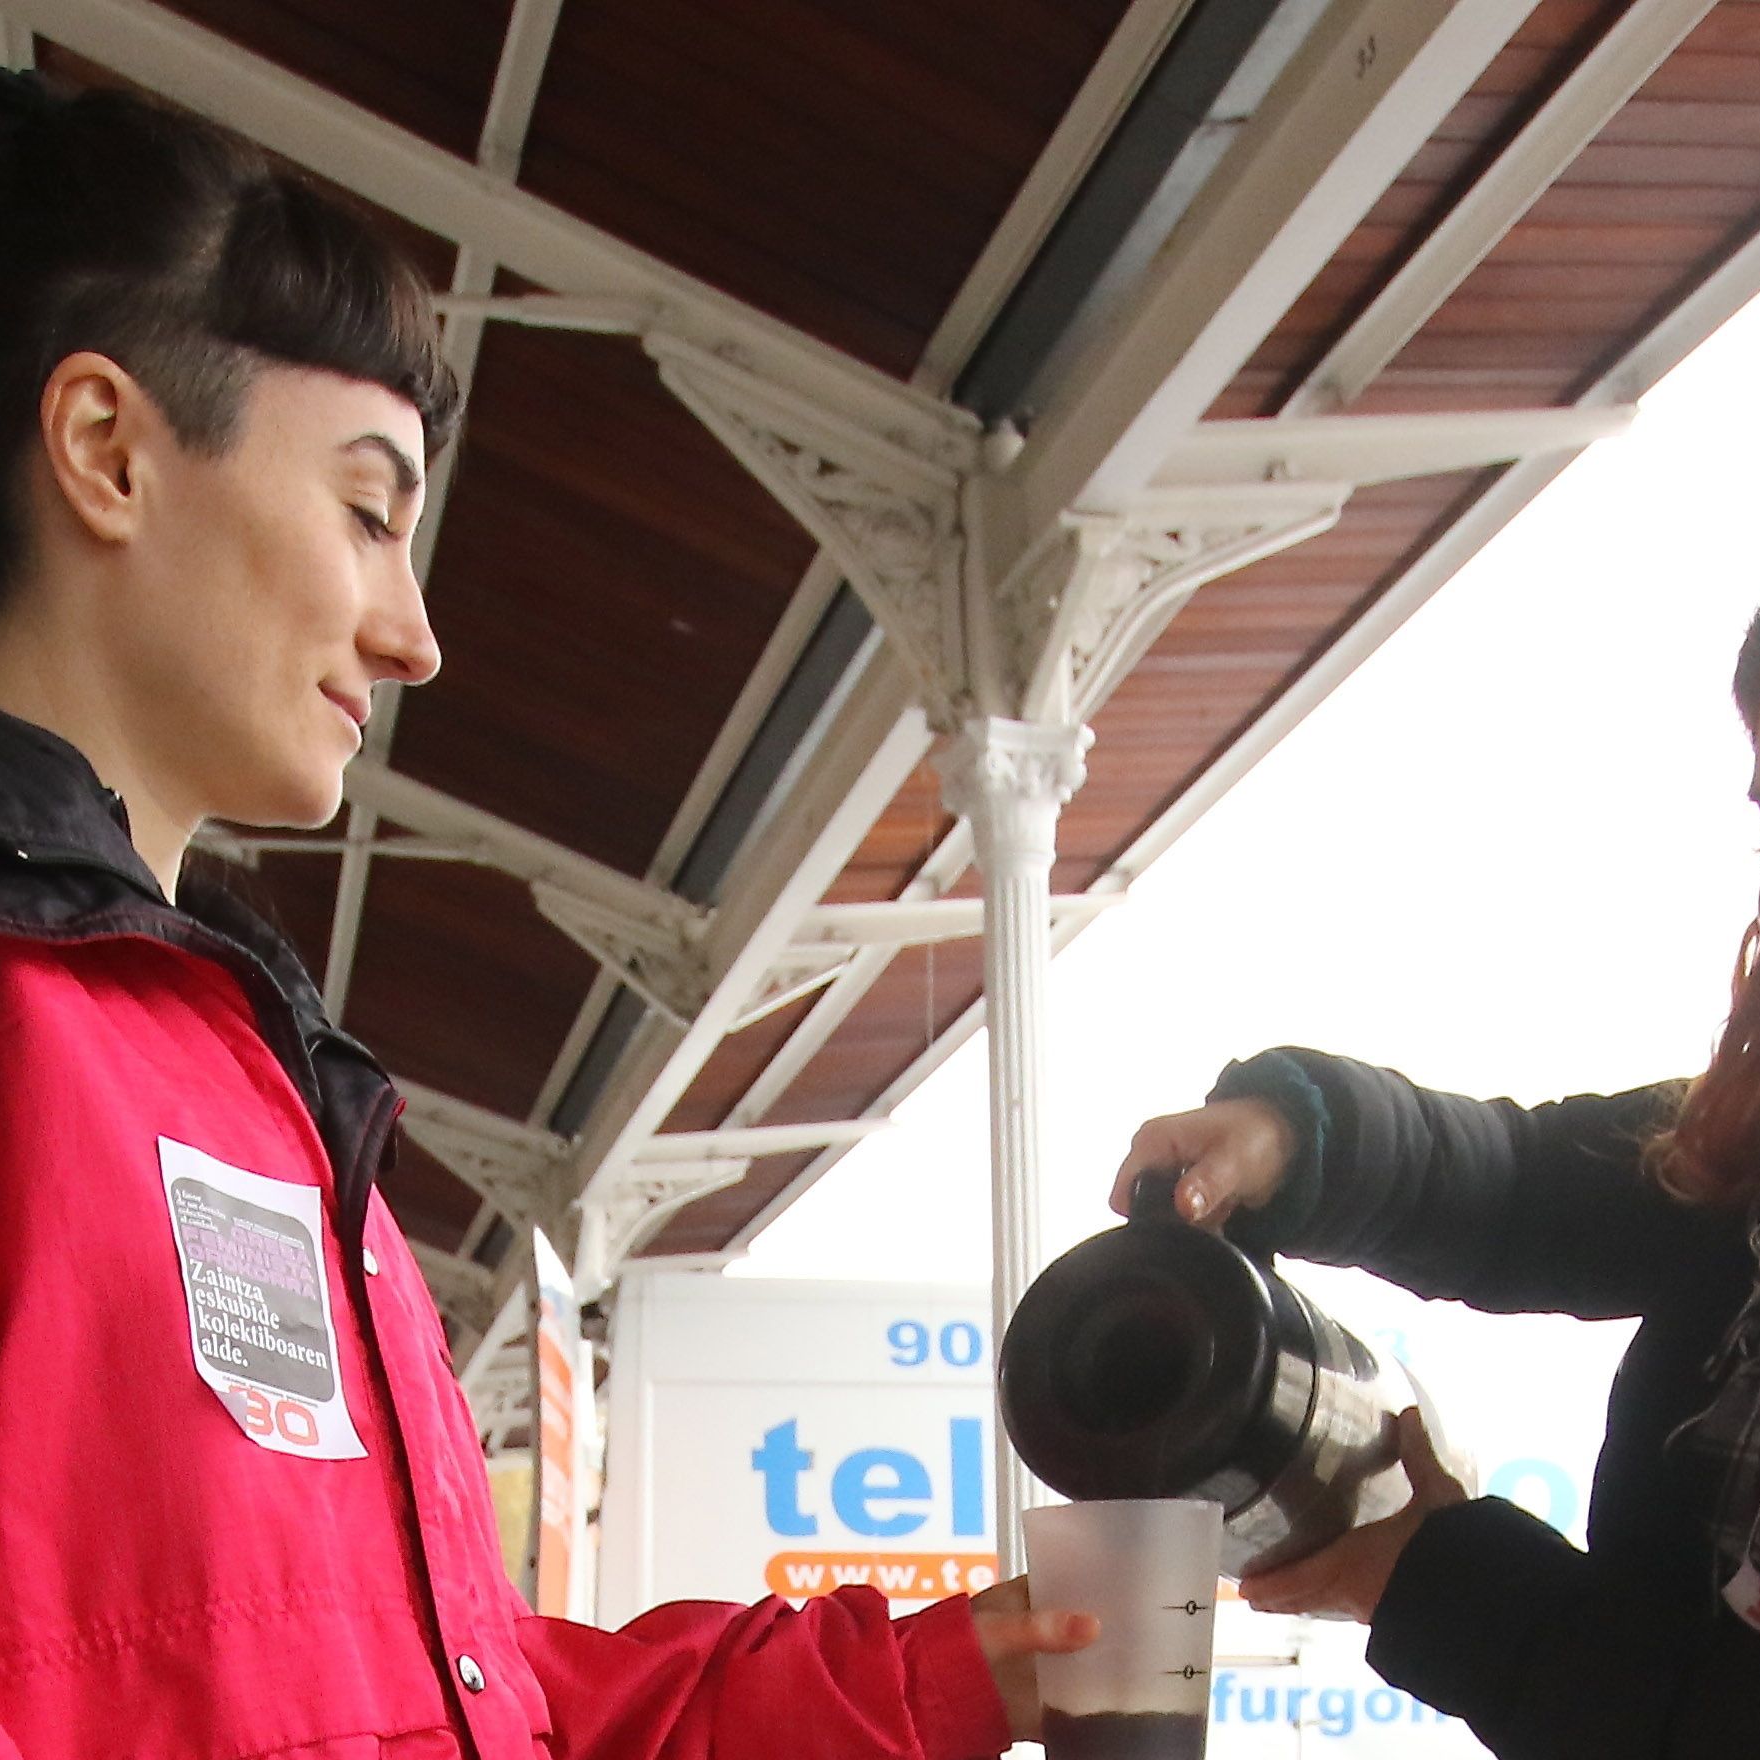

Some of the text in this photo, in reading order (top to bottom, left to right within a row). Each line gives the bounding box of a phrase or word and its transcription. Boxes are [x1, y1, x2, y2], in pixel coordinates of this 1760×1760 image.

[190, 1259, 264, 1303] Zaintza
[195, 1288, 280, 1330] eskubide
[198, 1305, 328, 1370] kolektiboaren
[201, 1334, 249, 1367] alde.
[887, 1319, 982, 1367] 90
[751, 1416, 985, 1538] tel
[785, 1558, 996, 1591] www.te
